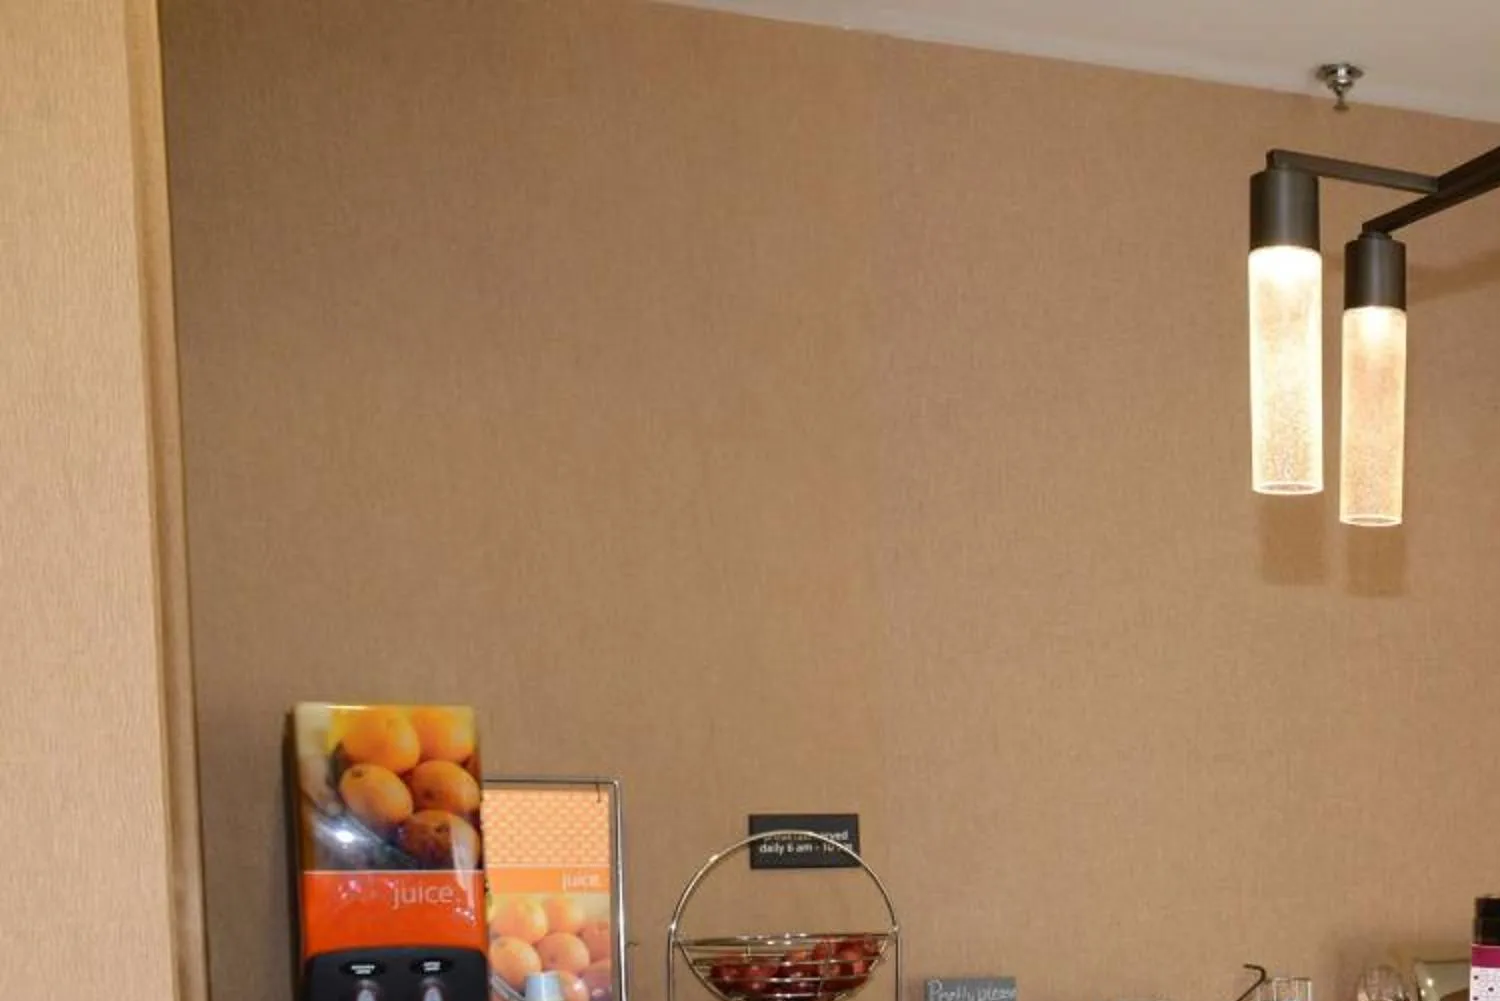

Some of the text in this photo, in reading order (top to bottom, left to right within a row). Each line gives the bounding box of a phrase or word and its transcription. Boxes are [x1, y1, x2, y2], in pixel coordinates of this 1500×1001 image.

[760, 842, 785, 856] daily
[796, 844, 813, 853] am
[390, 879, 453, 910] juice
